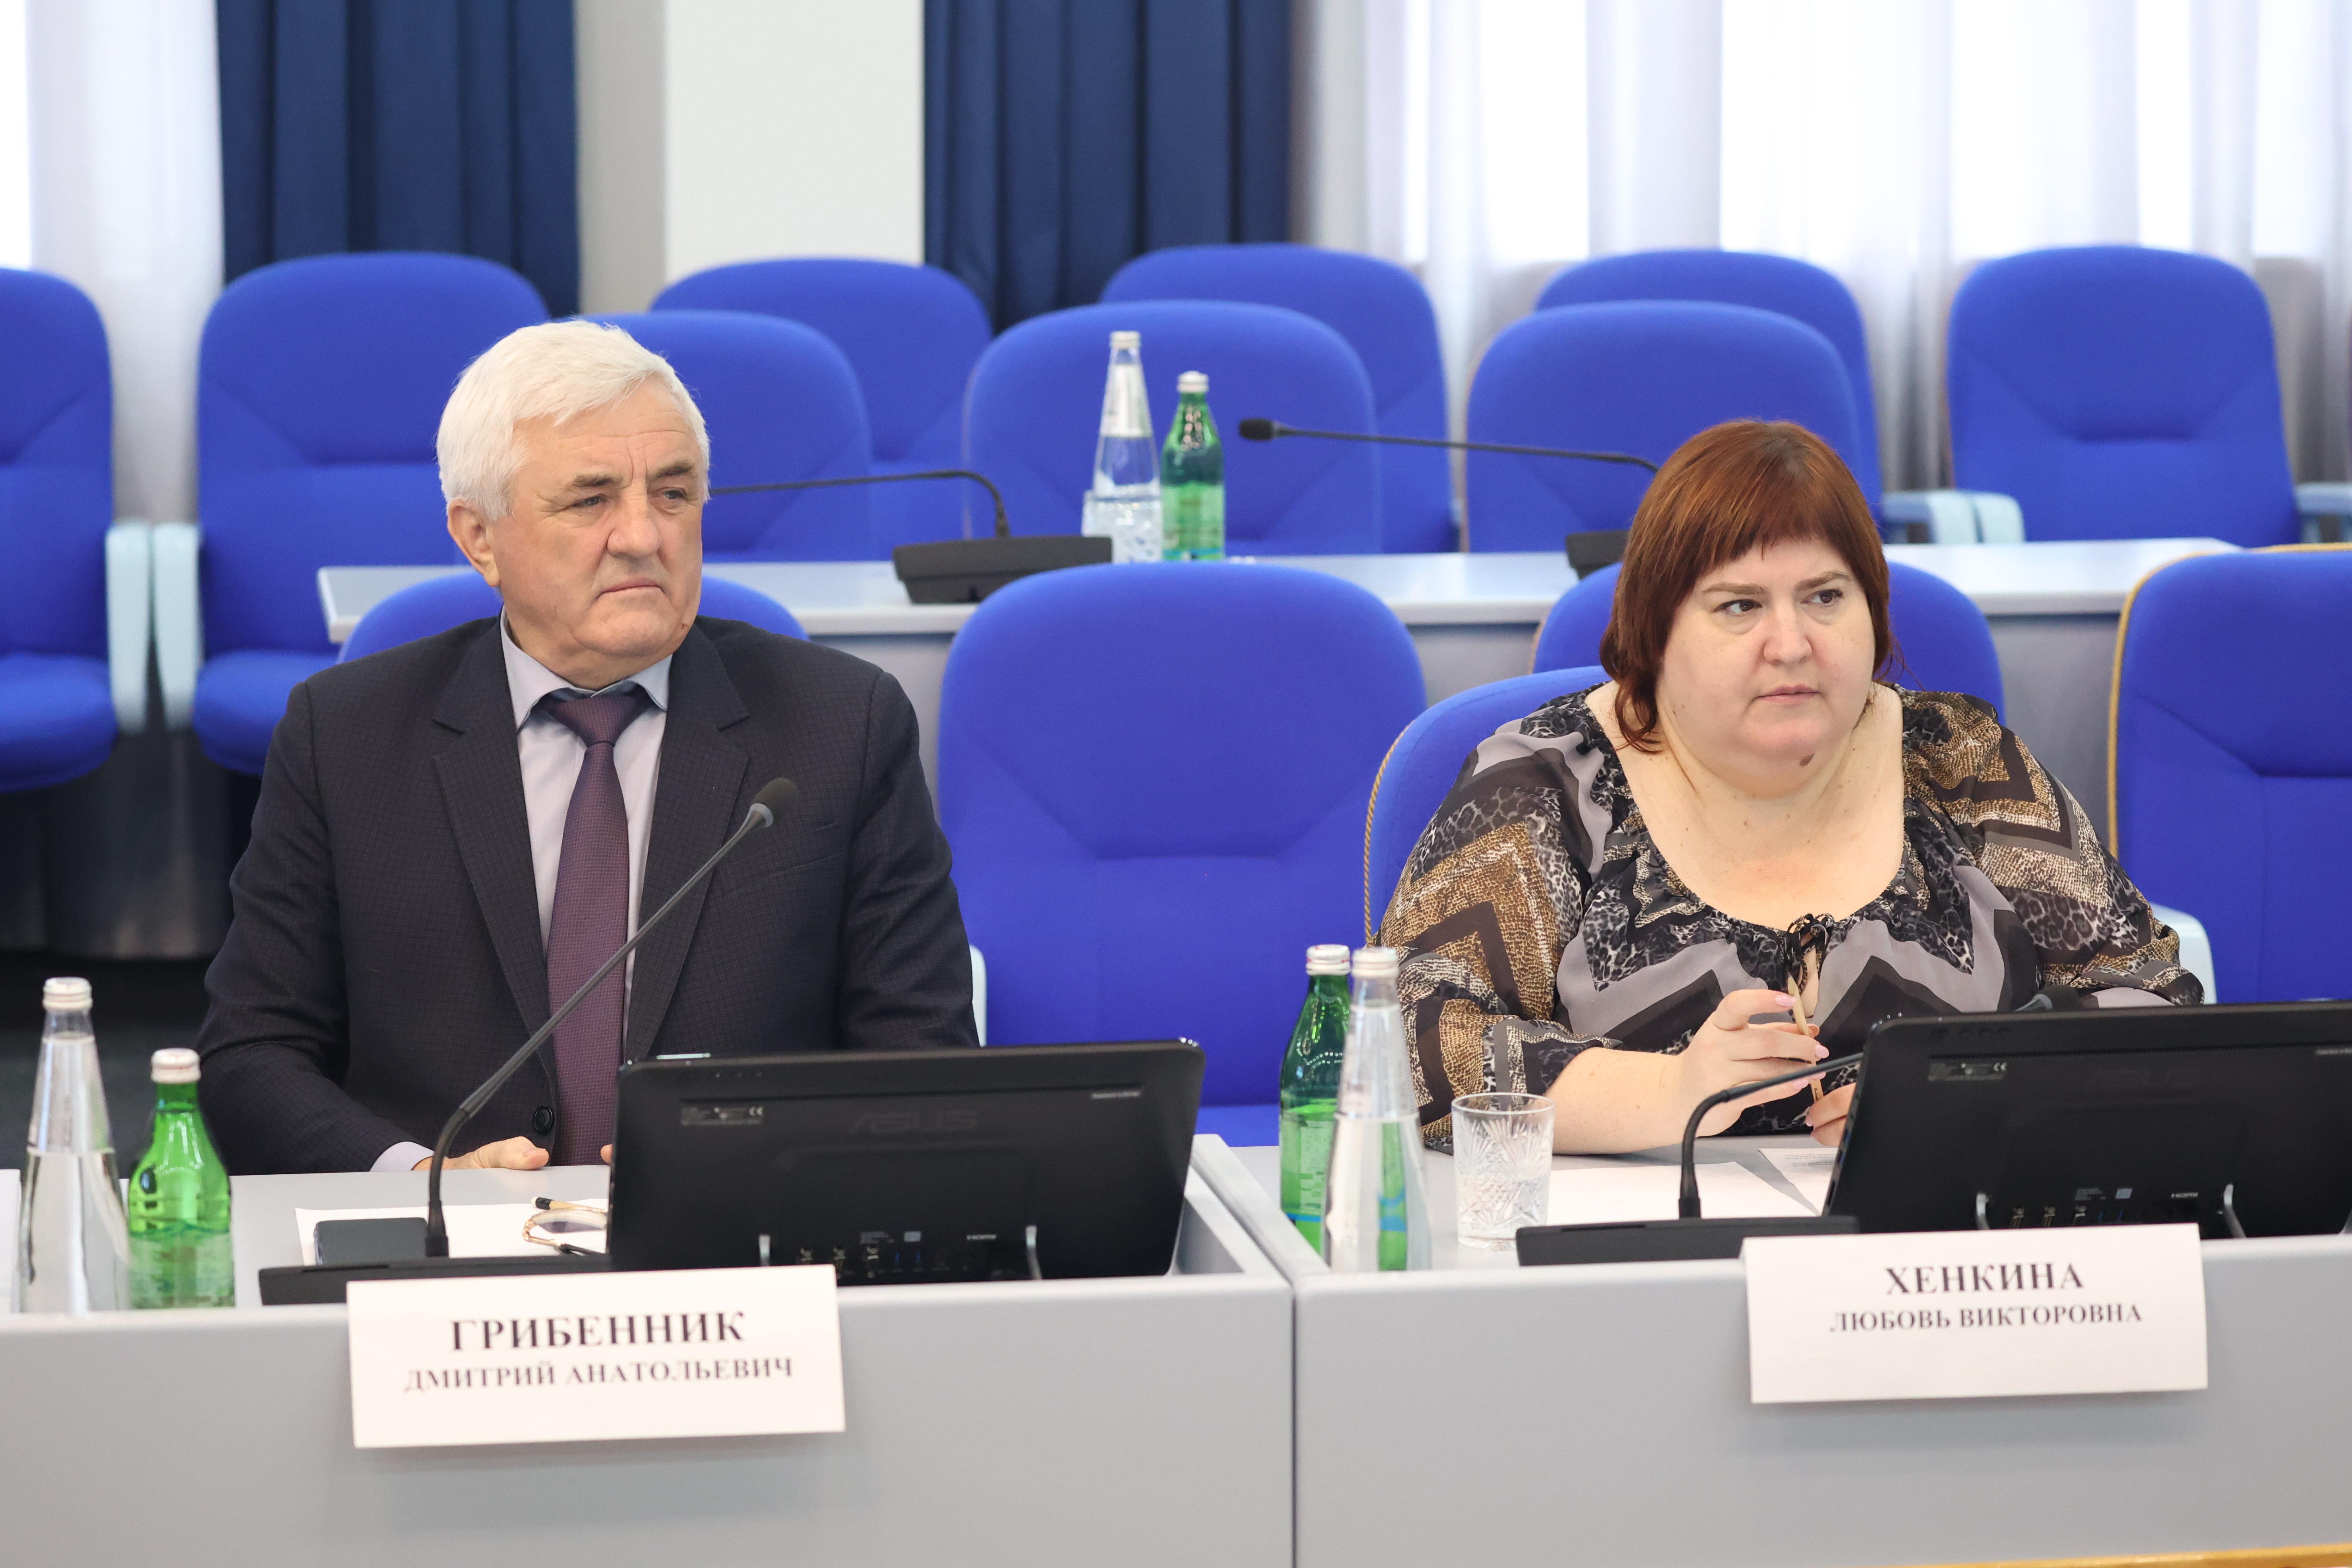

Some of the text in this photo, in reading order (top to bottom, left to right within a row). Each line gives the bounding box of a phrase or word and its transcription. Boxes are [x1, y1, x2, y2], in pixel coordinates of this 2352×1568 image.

[1886, 1262, 2084, 1295] ХЕНКИНА
[452, 1311, 744, 1351] ГРИБЕННИК
[1830, 1303, 2142, 1332] ЛЮБОВЬ ВИКТОРОВНА
[405, 1358, 792, 1392] ДМИТРИЙ АНАТОЛЬЕВИЧ
